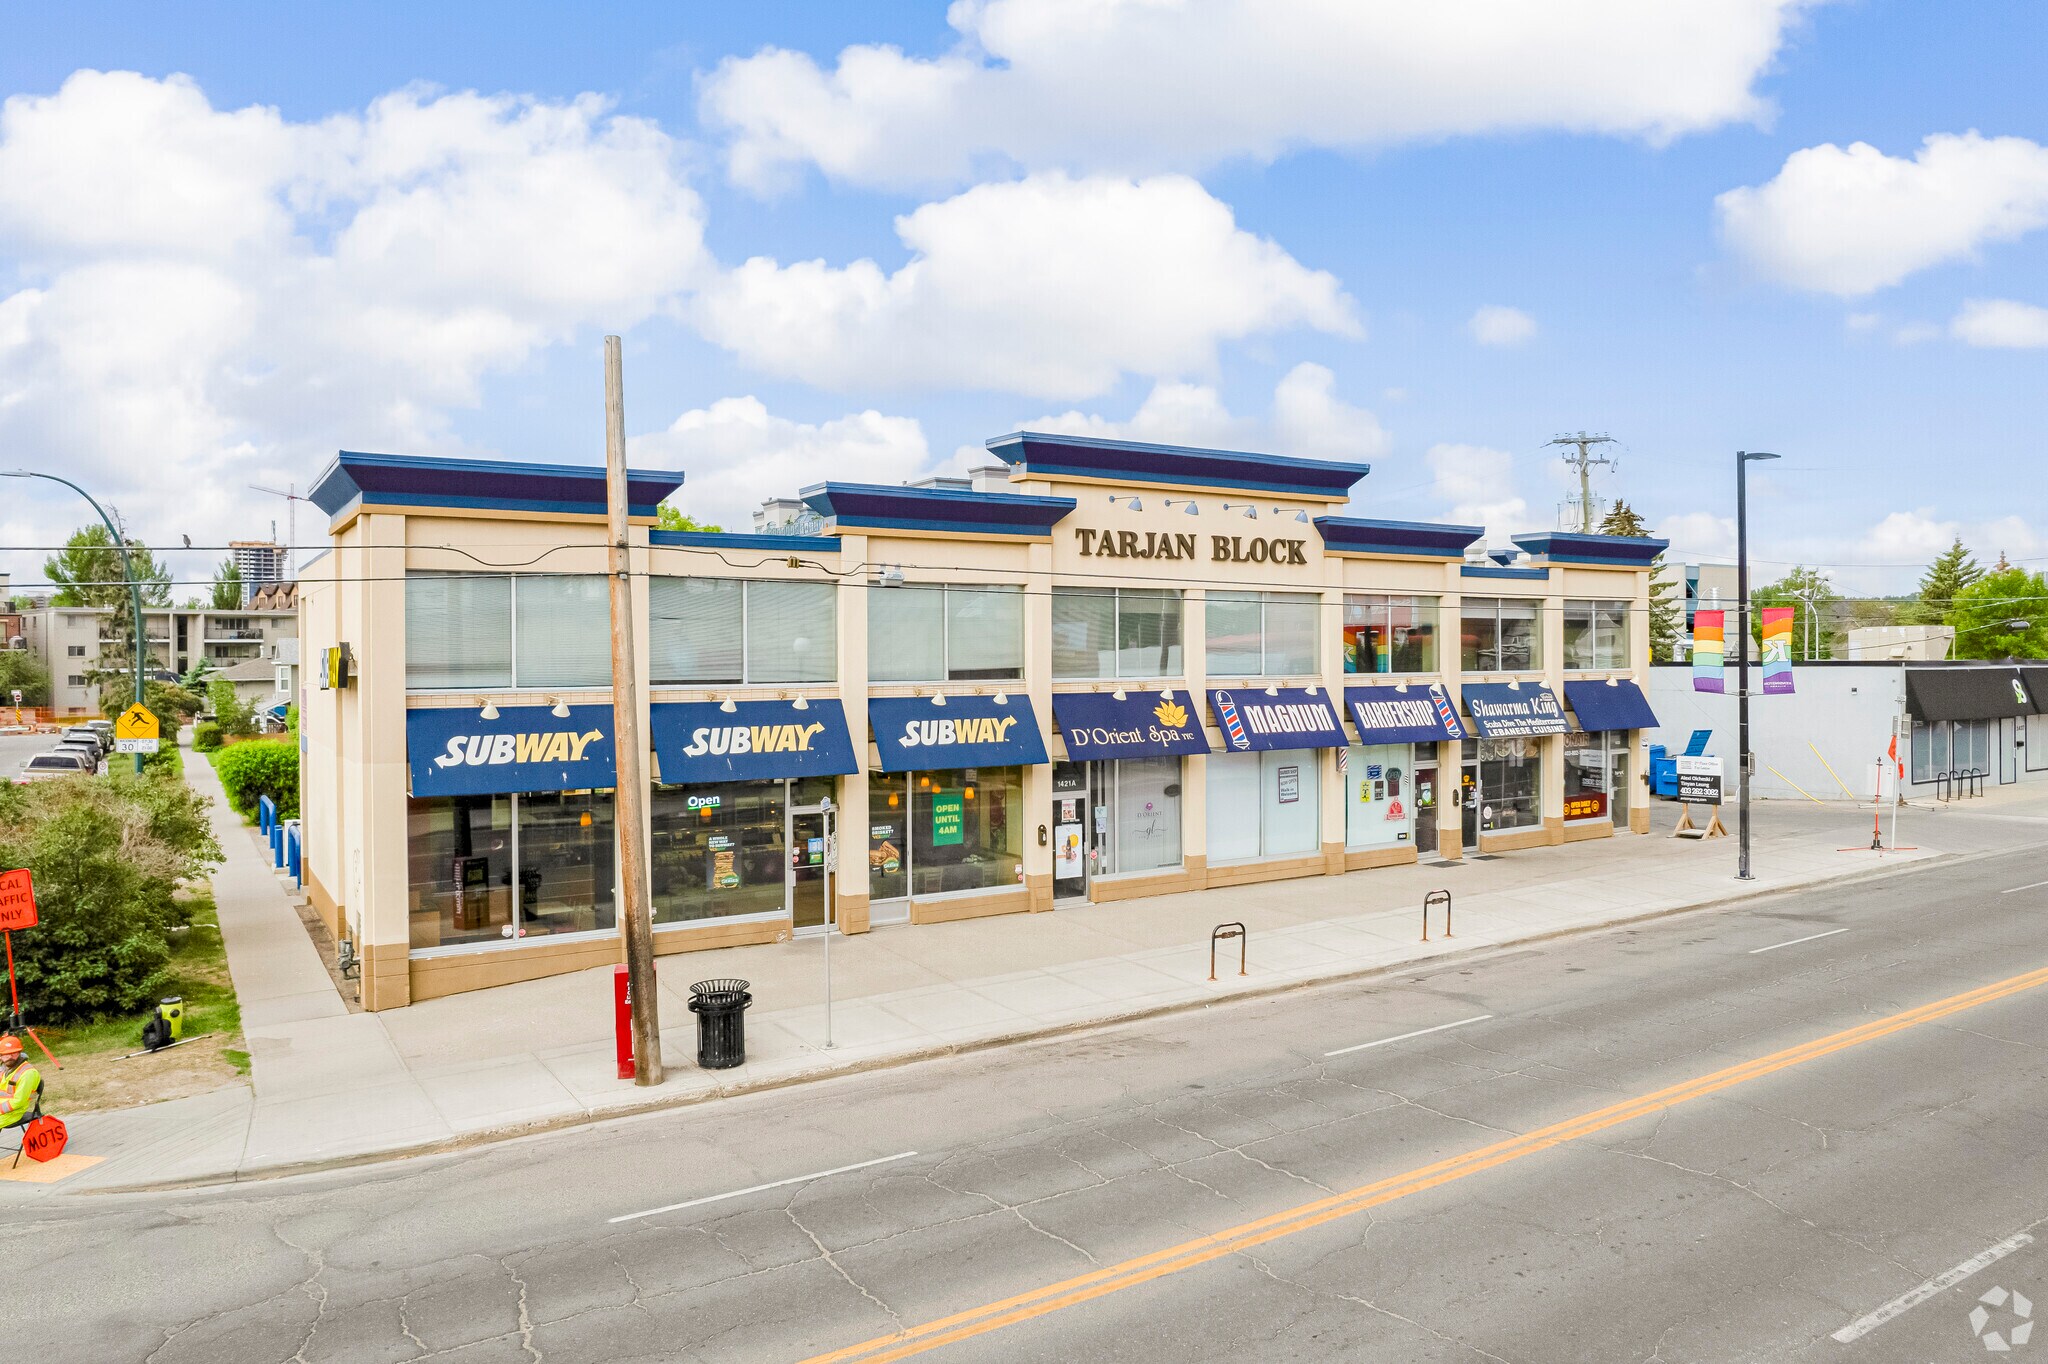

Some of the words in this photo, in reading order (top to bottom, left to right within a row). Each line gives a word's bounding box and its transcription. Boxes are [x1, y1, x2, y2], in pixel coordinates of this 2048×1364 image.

[1075, 528, 1196, 560] TARJAN
[1211, 535, 1307, 565] BLOCK
[1354, 700, 1436, 729] BARBERSHOP
[1472, 699, 1530, 717] Shawarma
[1530, 697, 1559, 717] King
[1243, 704, 1335, 734] MAGNUM
[683, 721, 825, 758] SUBWAY
[897, 715, 1017, 748] SUBWAY
[1071, 727, 1145, 746] D'Orient
[1149, 725, 1180, 747] Spa
[1488, 726, 1530, 737] LEBANESE
[1533, 725, 1567, 734] CUISINE
[433, 728, 604, 769] SUBWAY
[1057, 780, 1076, 788] 1421A
[688, 796, 720, 808] Open
[936, 804, 960, 813] OPEN
[935, 815, 960, 824] UNTIL
[938, 826, 957, 835] 4AM
[28, 1126, 64, 1153] SLOW
